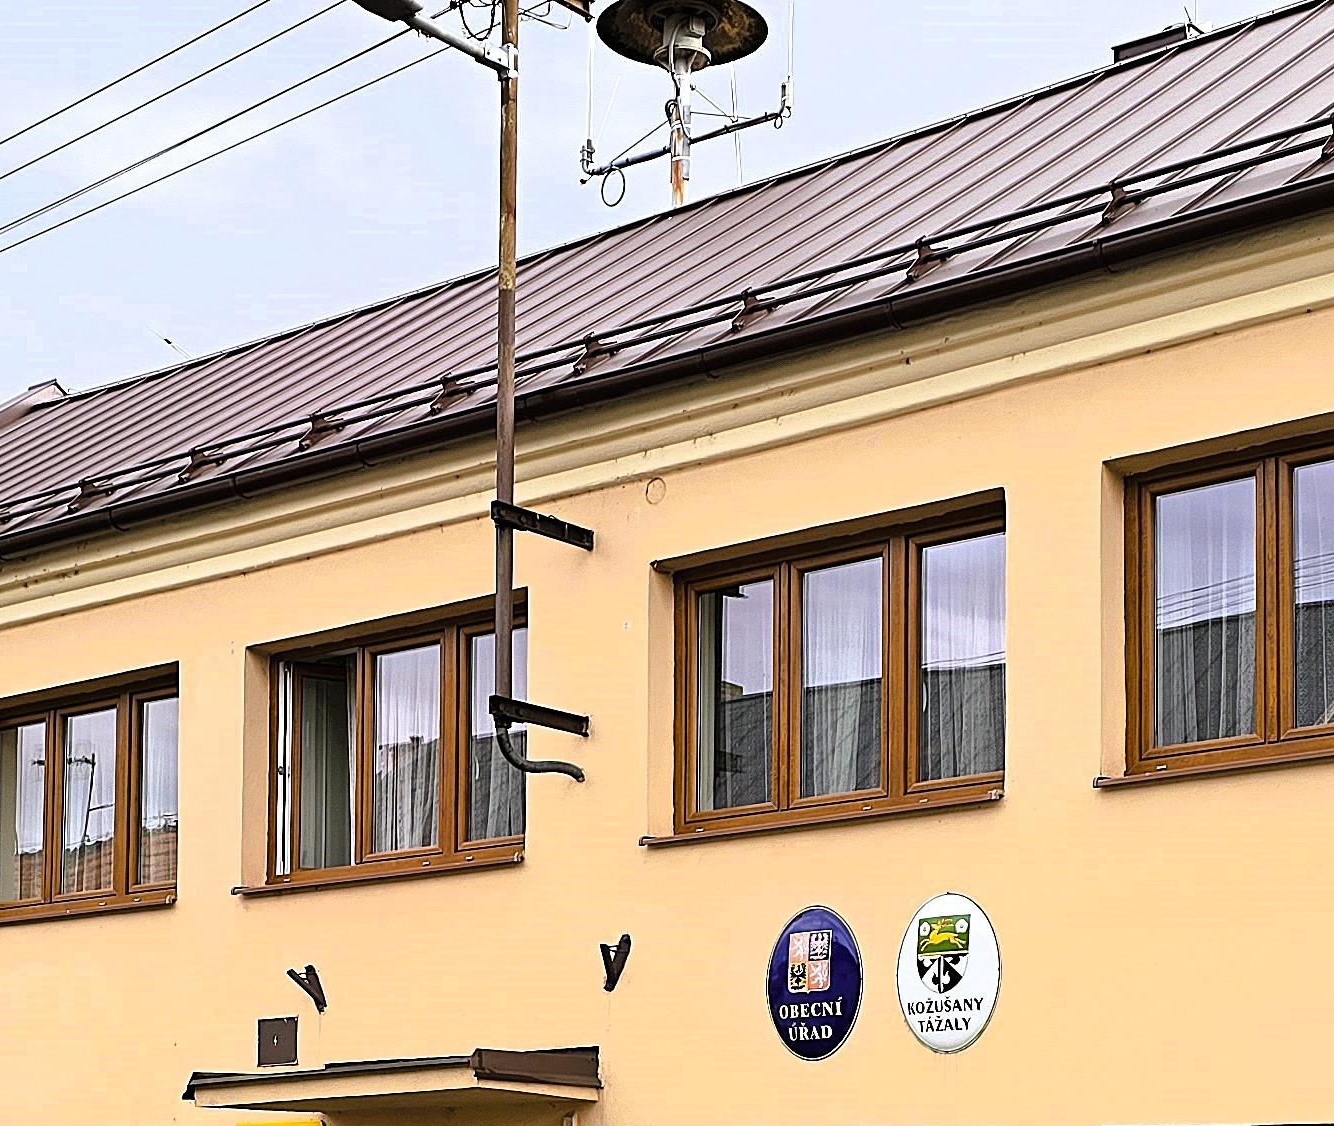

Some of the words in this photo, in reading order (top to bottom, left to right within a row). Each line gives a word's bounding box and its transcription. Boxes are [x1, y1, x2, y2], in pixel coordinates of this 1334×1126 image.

[779, 996, 843, 1019] OBECNÍ
[907, 997, 984, 1016] KOŽUŠANY
[788, 1022, 833, 1042] ÚŘAD
[917, 1015, 971, 1033] TÁŽALY
